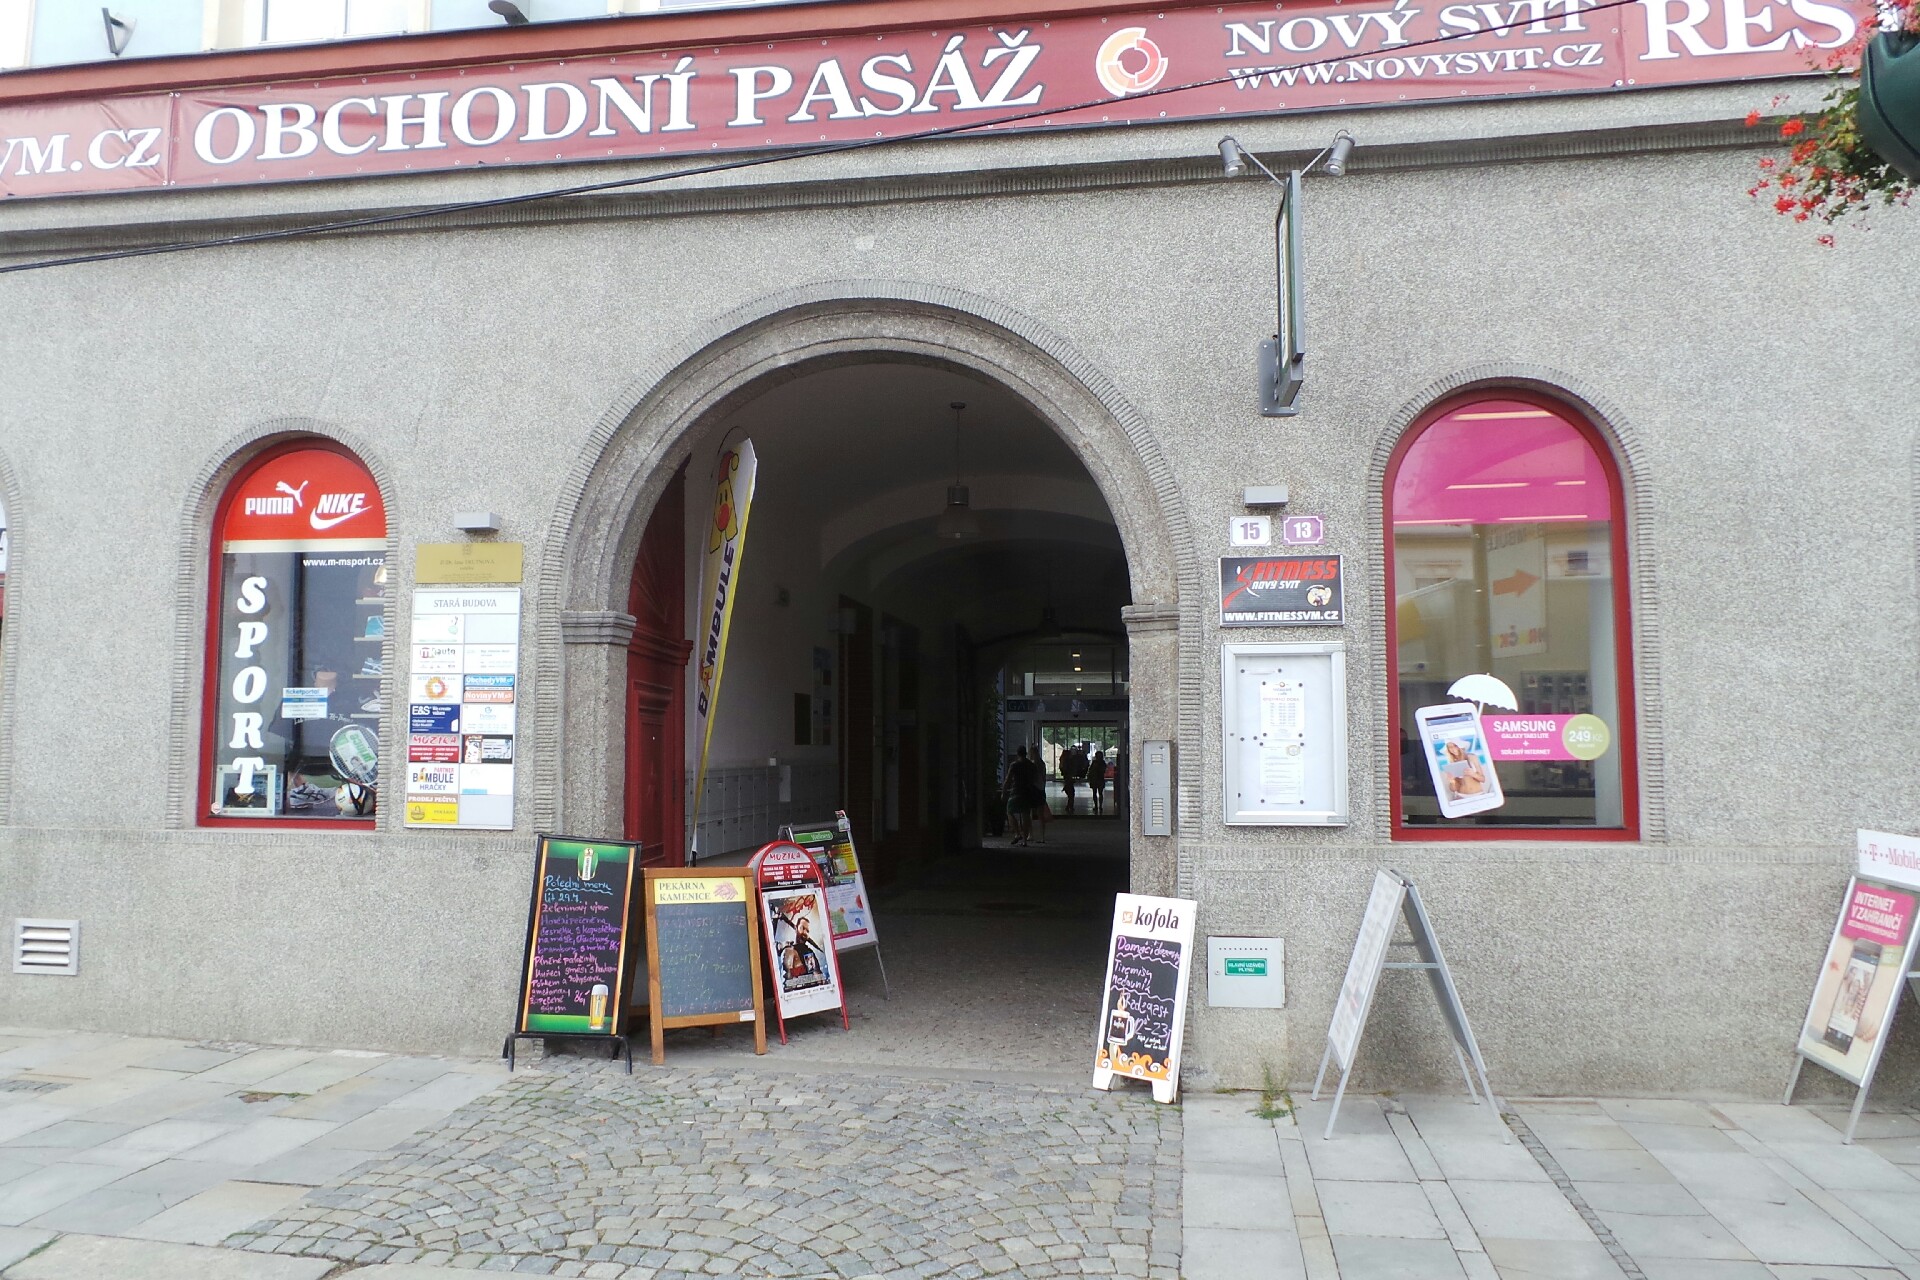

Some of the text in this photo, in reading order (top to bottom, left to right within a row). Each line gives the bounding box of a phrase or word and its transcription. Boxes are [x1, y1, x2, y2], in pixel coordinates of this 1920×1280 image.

[1225, 0, 1596, 56] NOVÝ SVIT
[1228, 43, 1604, 90] WWW.NOVYSVIT.CZ
[194, 30, 1044, 164] OBCHODNÍ PASÁŽ
[245, 492, 366, 516] PUMA NIKE
[1240, 521, 1261, 540] 15
[1293, 521, 1312, 539] 13
[303, 557, 384, 568] www.m-msport.cz
[1251, 560, 1338, 581] FITNESS
[1279, 580, 1301, 589] SVIT
[433, 597, 497, 608] STARÁ BUDOVA
[1224, 610, 1339, 622] WWW.FITNESSVM.CZ
[229, 576, 268, 795] SPORT
[412, 705, 430, 716] E&S
[1493, 720, 1556, 732] SAMSUNG
[1568, 730, 1591, 743] 249
[419, 783, 447, 791] HRAČKY
[659, 881, 705, 891] PEKÁRNA
[659, 892, 711, 902] KAMENICE
[1853, 890, 1896, 913] INTERNET
[1134, 905, 1179, 933] kofola
